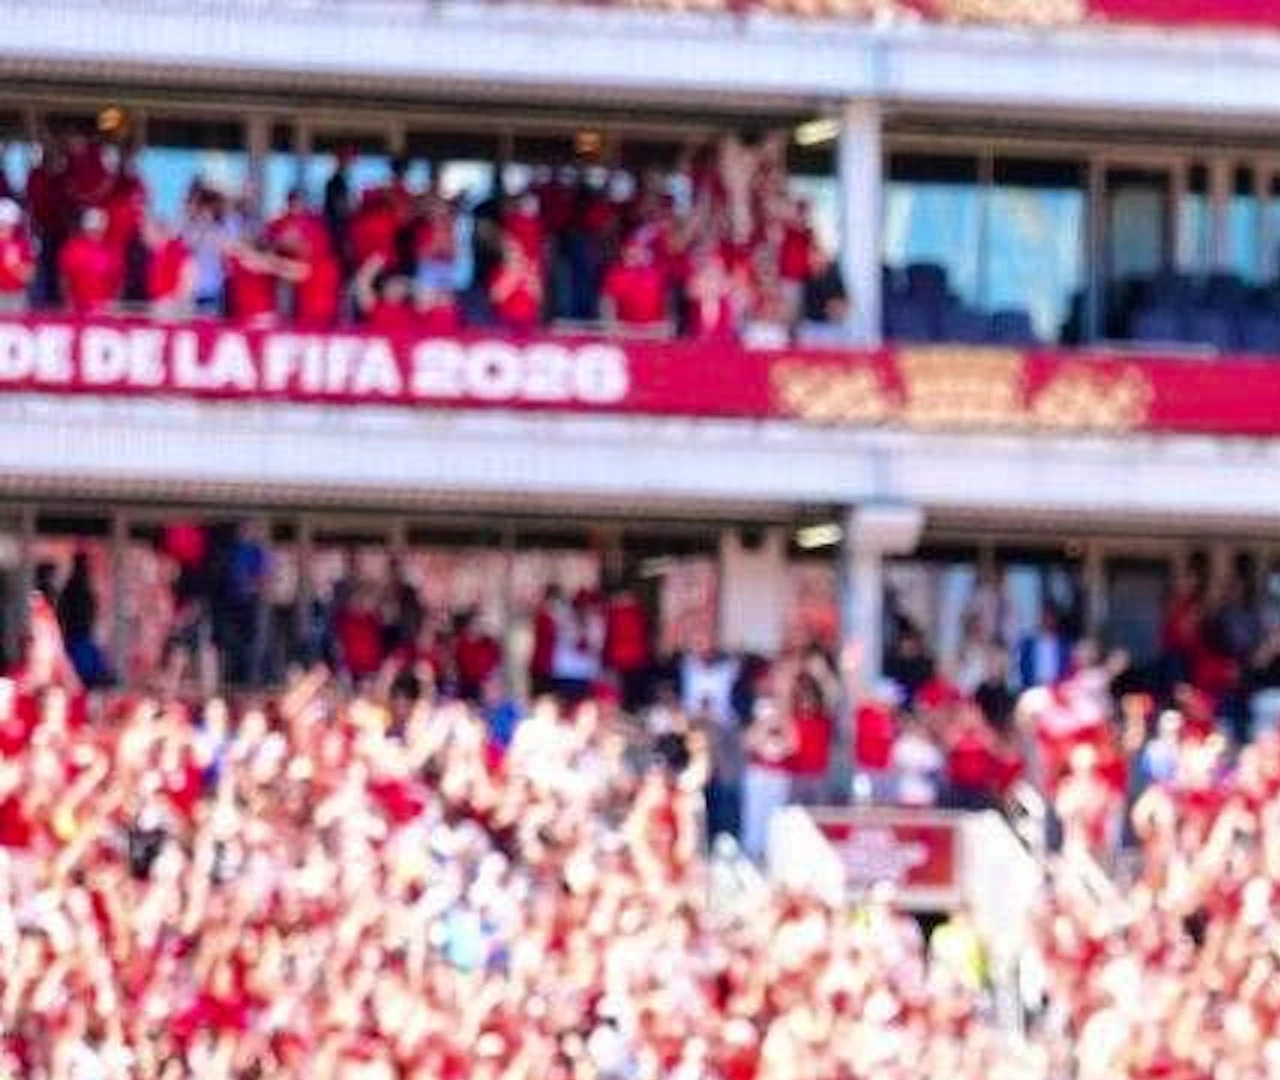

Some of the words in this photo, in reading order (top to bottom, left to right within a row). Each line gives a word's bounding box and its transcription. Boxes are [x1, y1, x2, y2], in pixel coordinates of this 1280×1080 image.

[80, 328, 166, 386] DE
[173, 332, 257, 391] LA
[263, 334, 401, 396] FIFA
[410, 339, 631, 401] 2026
